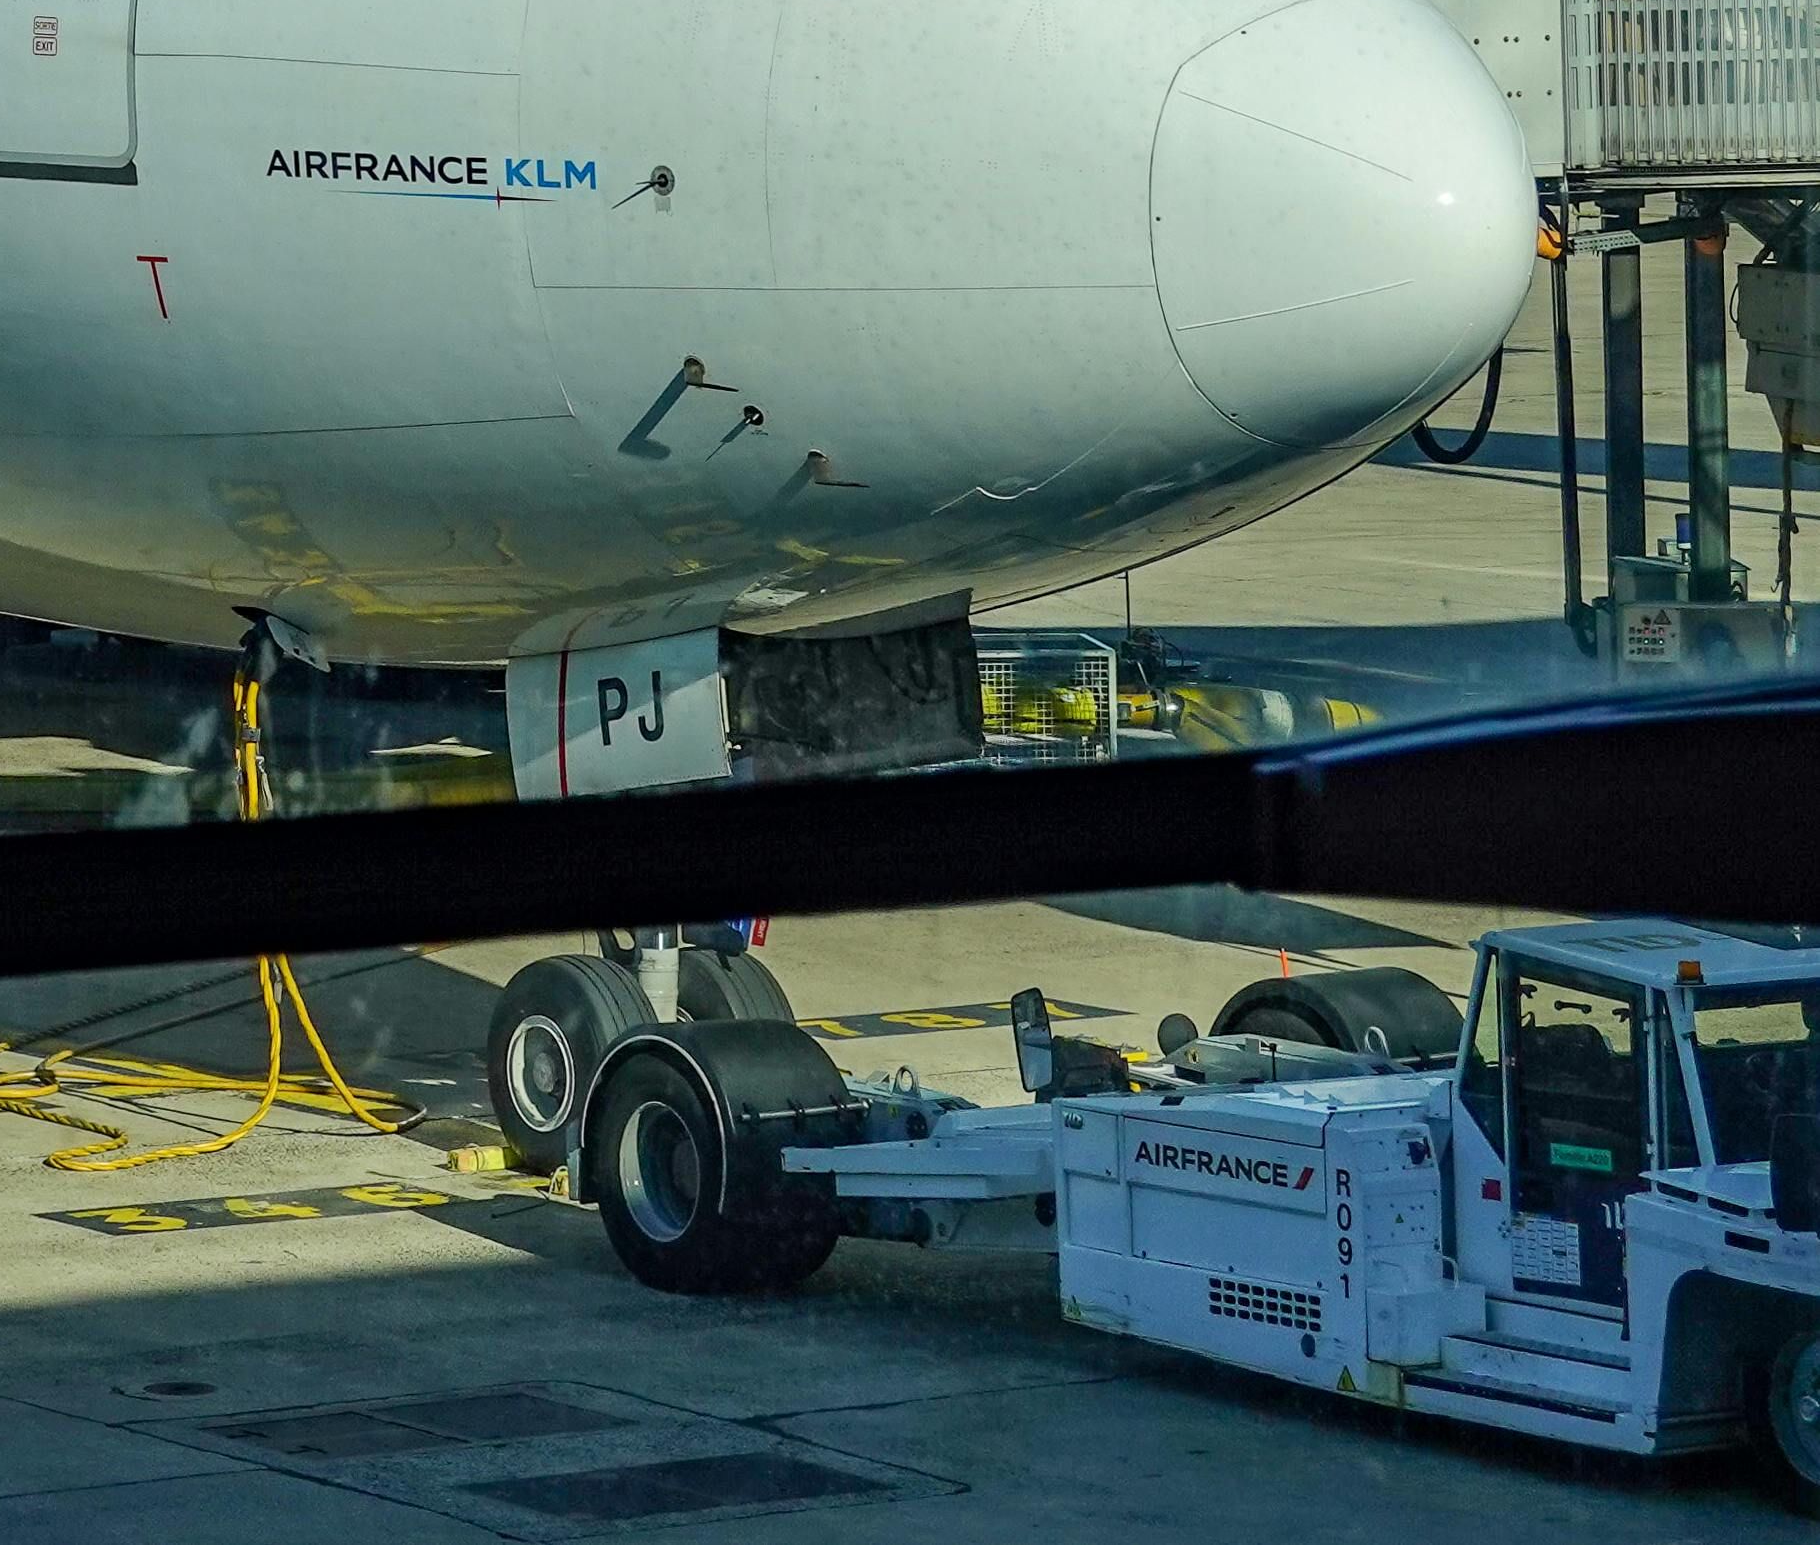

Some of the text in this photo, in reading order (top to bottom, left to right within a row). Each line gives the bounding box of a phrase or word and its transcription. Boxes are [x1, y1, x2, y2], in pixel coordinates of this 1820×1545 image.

[35, 41, 55, 52] EXIT
[266, 149, 597, 190] AIRFRANCE KLM
[597, 670, 664, 747] PJ
[1134, 1140, 1289, 1188] AIRFRANCE
[1335, 1168, 1353, 1300] R091
